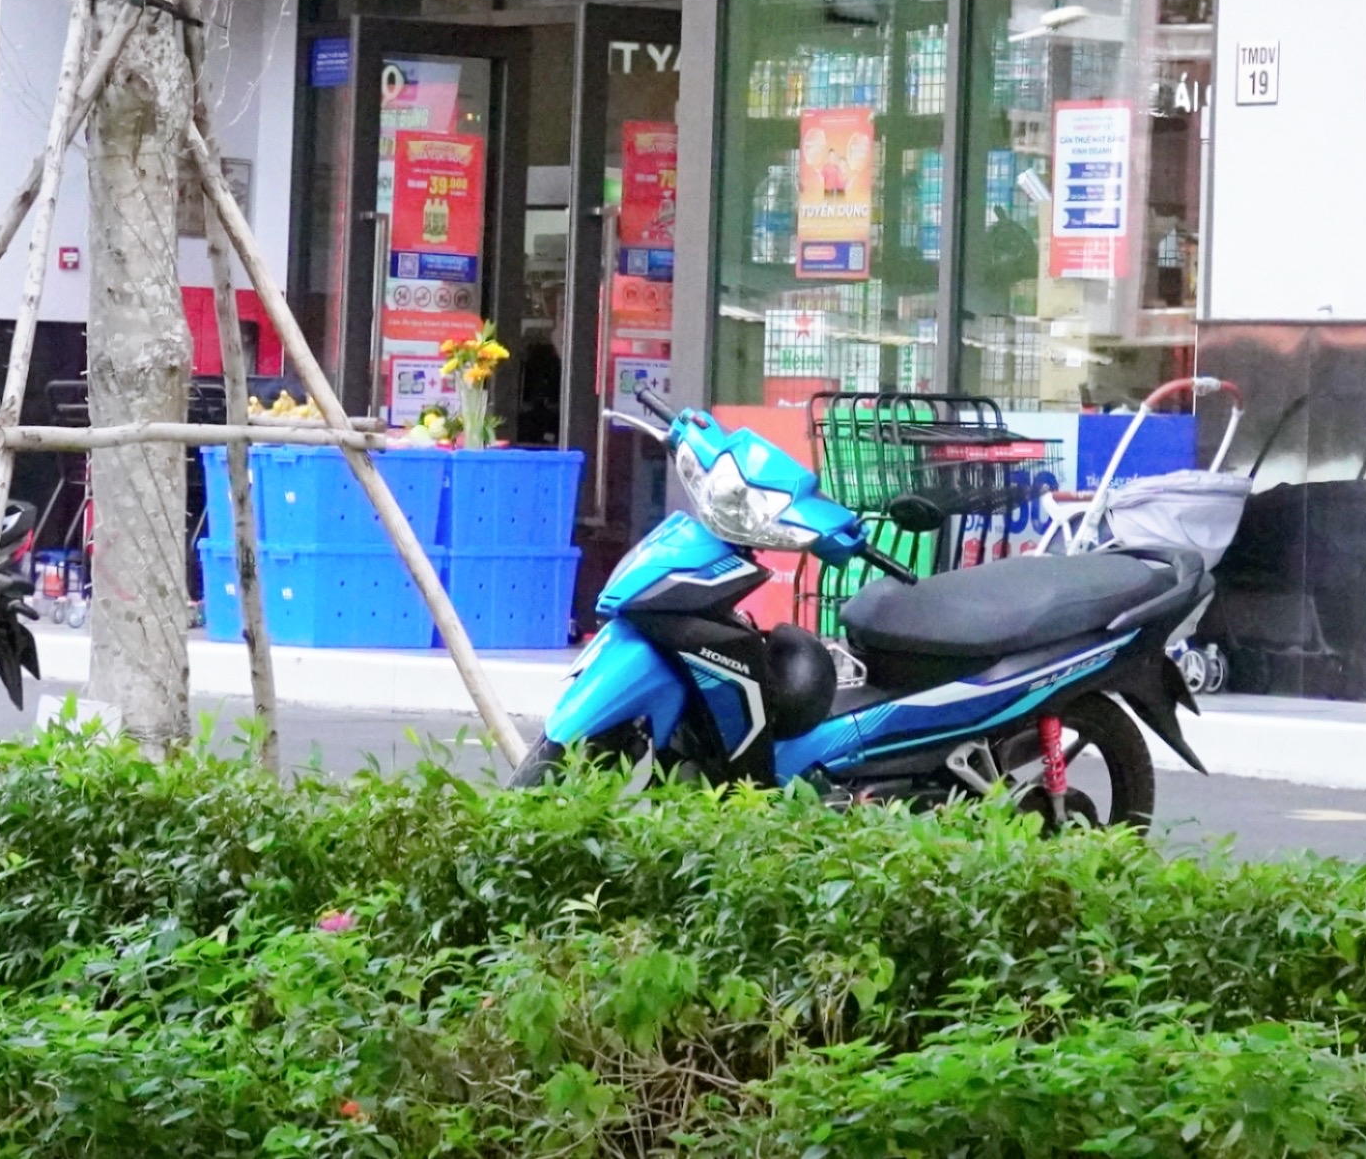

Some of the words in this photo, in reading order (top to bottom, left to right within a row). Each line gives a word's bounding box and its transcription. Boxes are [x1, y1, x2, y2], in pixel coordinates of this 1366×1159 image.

[1241, 47, 1276, 65] TMDV
[1248, 70, 1269, 96] 19
[699, 647, 750, 675] HONDA
